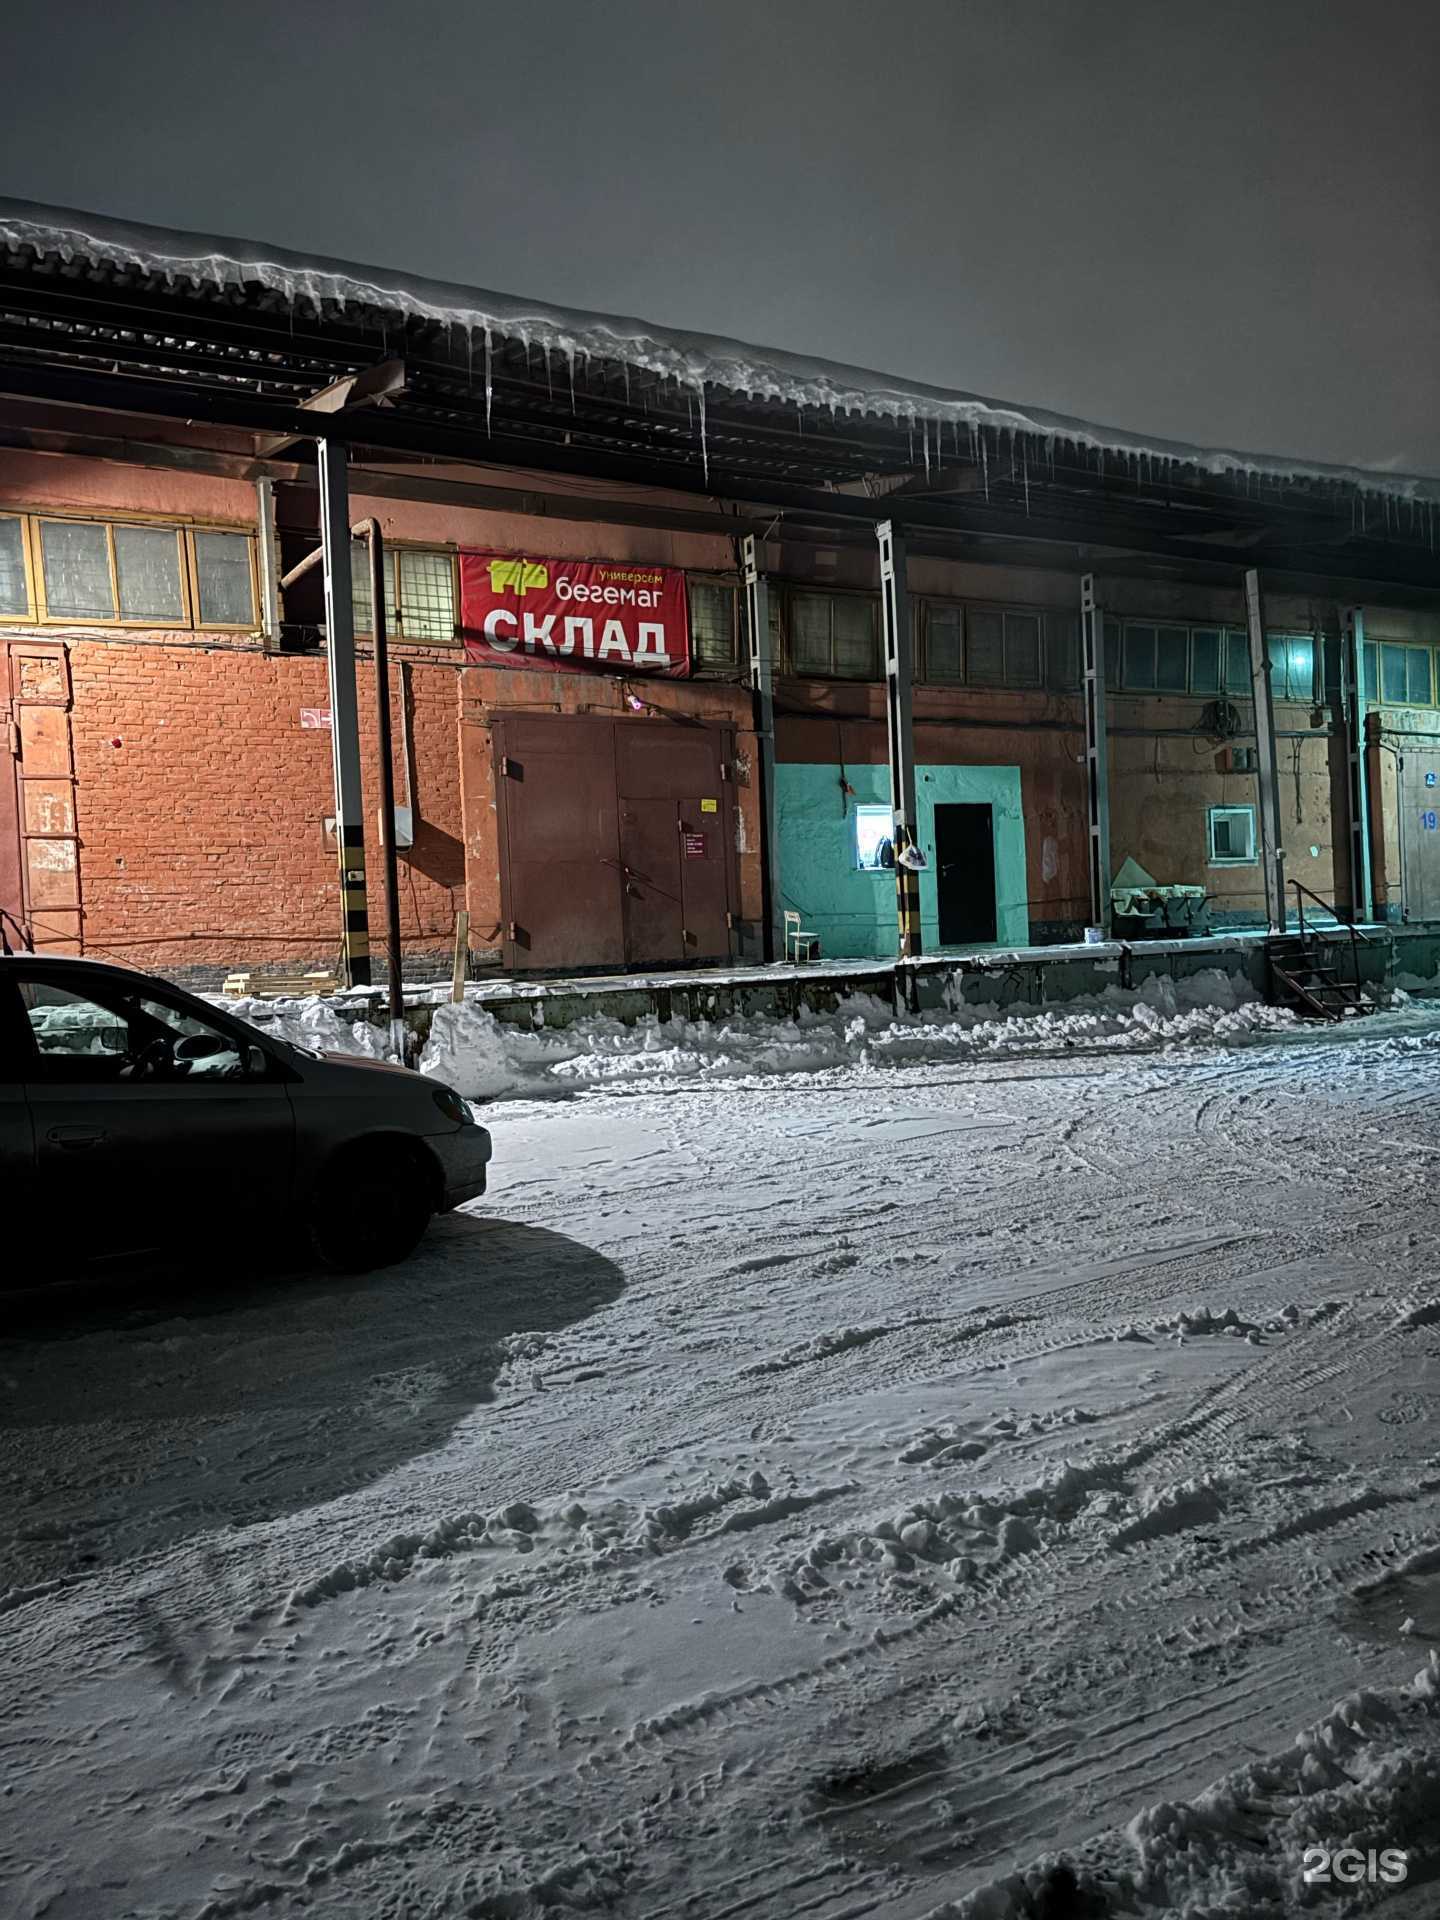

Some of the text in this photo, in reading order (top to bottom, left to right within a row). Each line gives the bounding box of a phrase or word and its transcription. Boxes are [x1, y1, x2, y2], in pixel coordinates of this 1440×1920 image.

[599, 568, 663, 585] универсам
[555, 576, 663, 609] бегемаг
[483, 608, 671, 672] СКЛАД
[1421, 811, 1437, 830] 19
